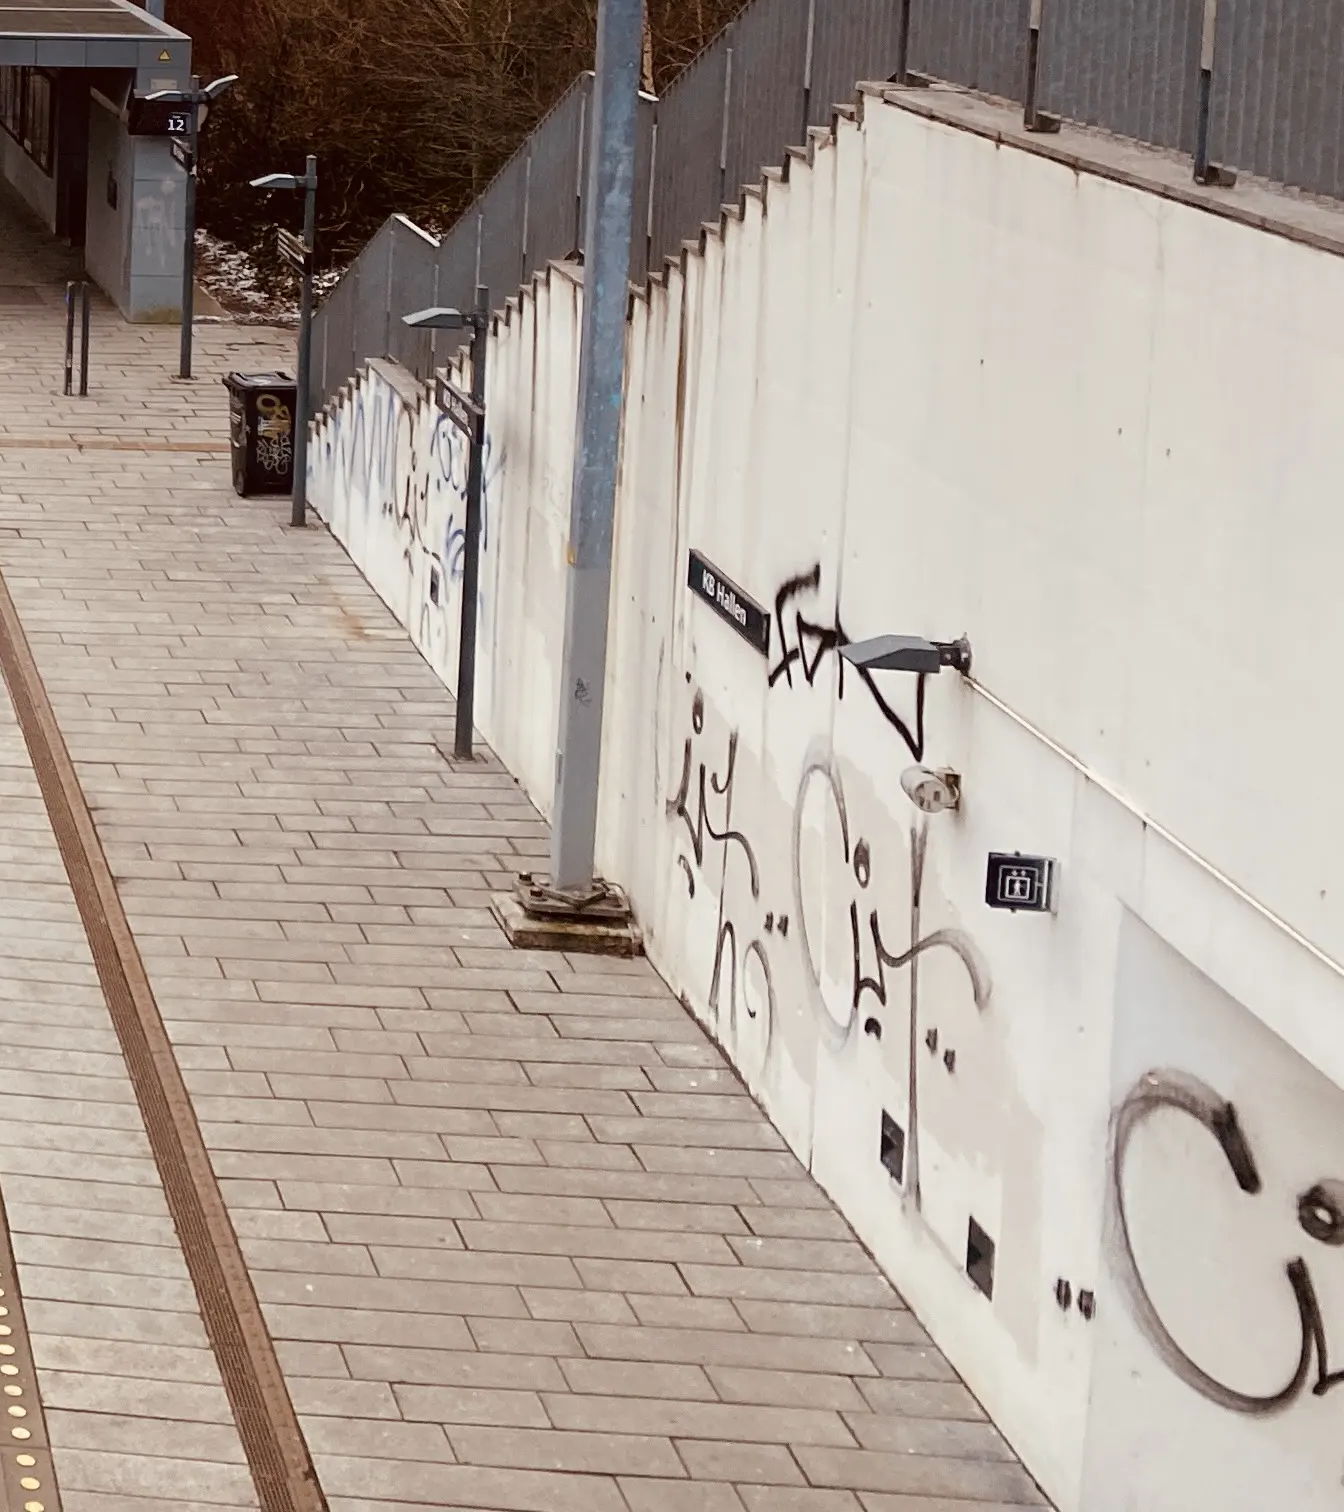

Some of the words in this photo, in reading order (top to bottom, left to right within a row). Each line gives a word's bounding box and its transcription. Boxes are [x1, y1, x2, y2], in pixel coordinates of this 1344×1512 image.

[167, 119, 185, 131] 12
[702, 568, 715, 597] KB
[716, 581, 748, 627] Hallen
